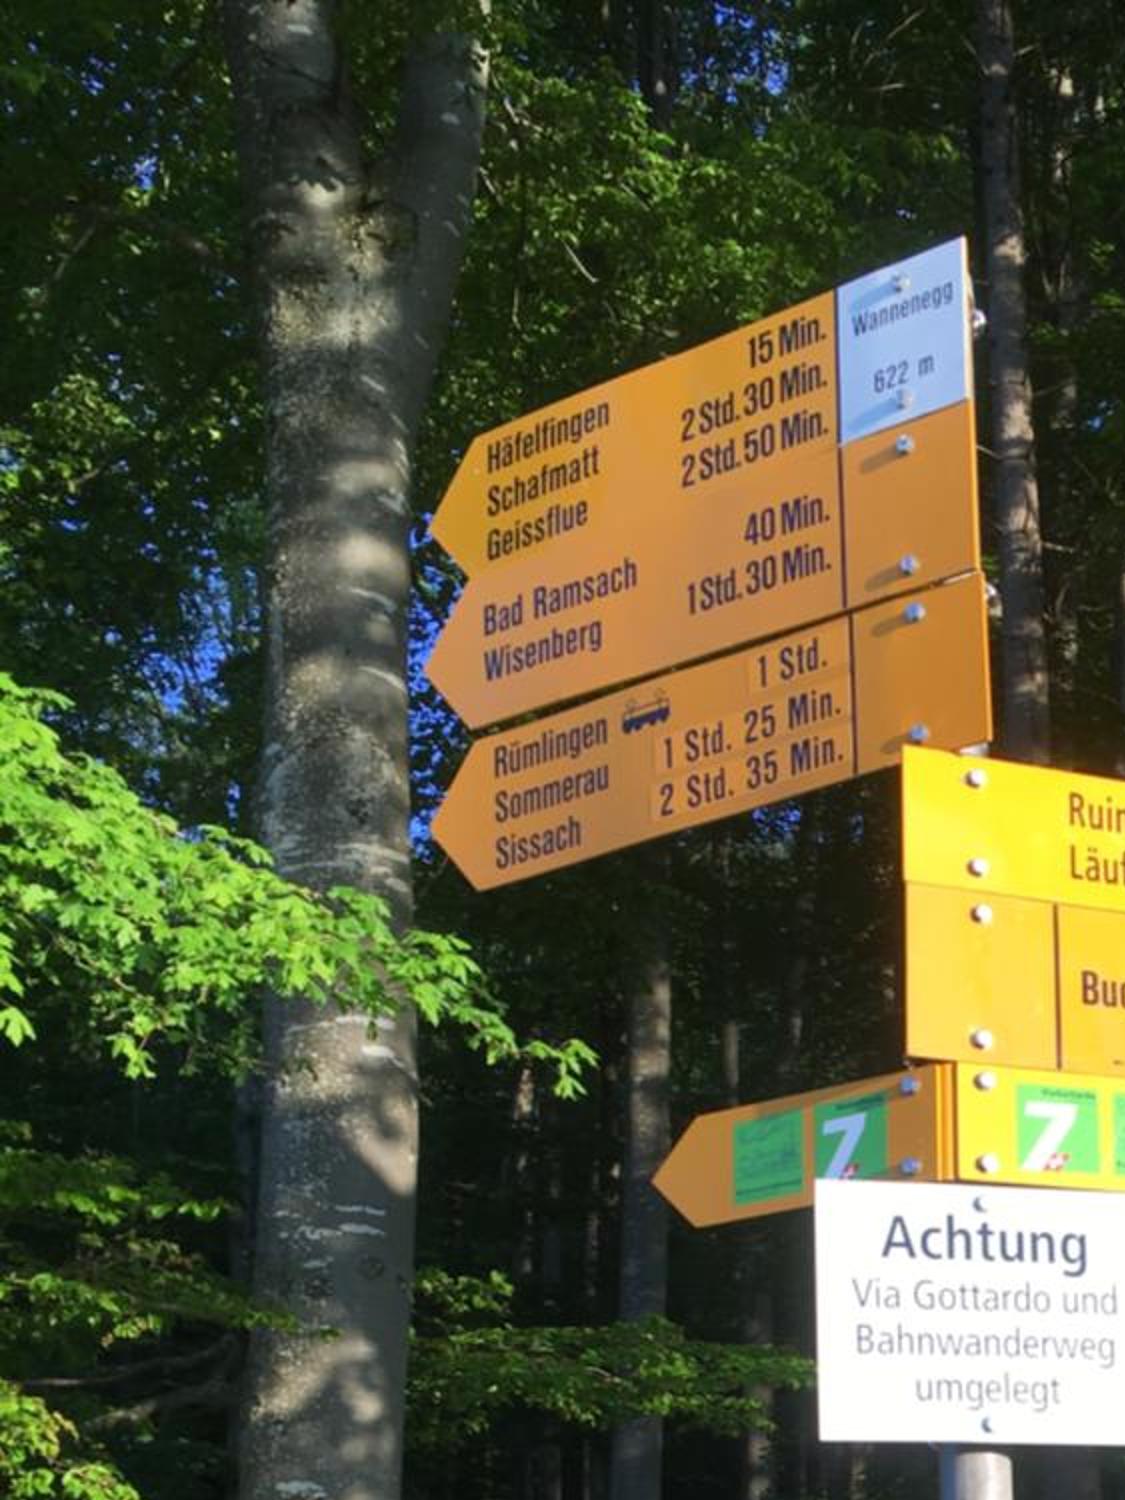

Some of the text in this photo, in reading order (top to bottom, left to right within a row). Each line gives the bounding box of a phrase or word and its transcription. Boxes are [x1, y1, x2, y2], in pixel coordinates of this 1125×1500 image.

[851, 281, 953, 337] Wannenegg
[873, 355, 935, 393] 622 m
[486, 401, 610, 475] Häfelfingen
[487, 445, 600, 517] Schafmatt
[486, 500, 589, 562] Geissflue
[483, 556, 638, 637] Bad Ramsach
[483, 620, 603, 682] Wisenberg
[494, 641, 828, 778] Rümlingen 1 Std.
[494, 689, 841, 824] Sommerau 1 Std. 25 Min.
[495, 736, 844, 870] Sissach 2 Std. 35 Min.
[881, 1213, 1088, 1278] Achtung
[851, 1277, 1118, 1316] Via Gottardo und
[855, 1322, 1116, 1370] Bahnwanderweg
[915, 1371, 1061, 1413] umgelegt
